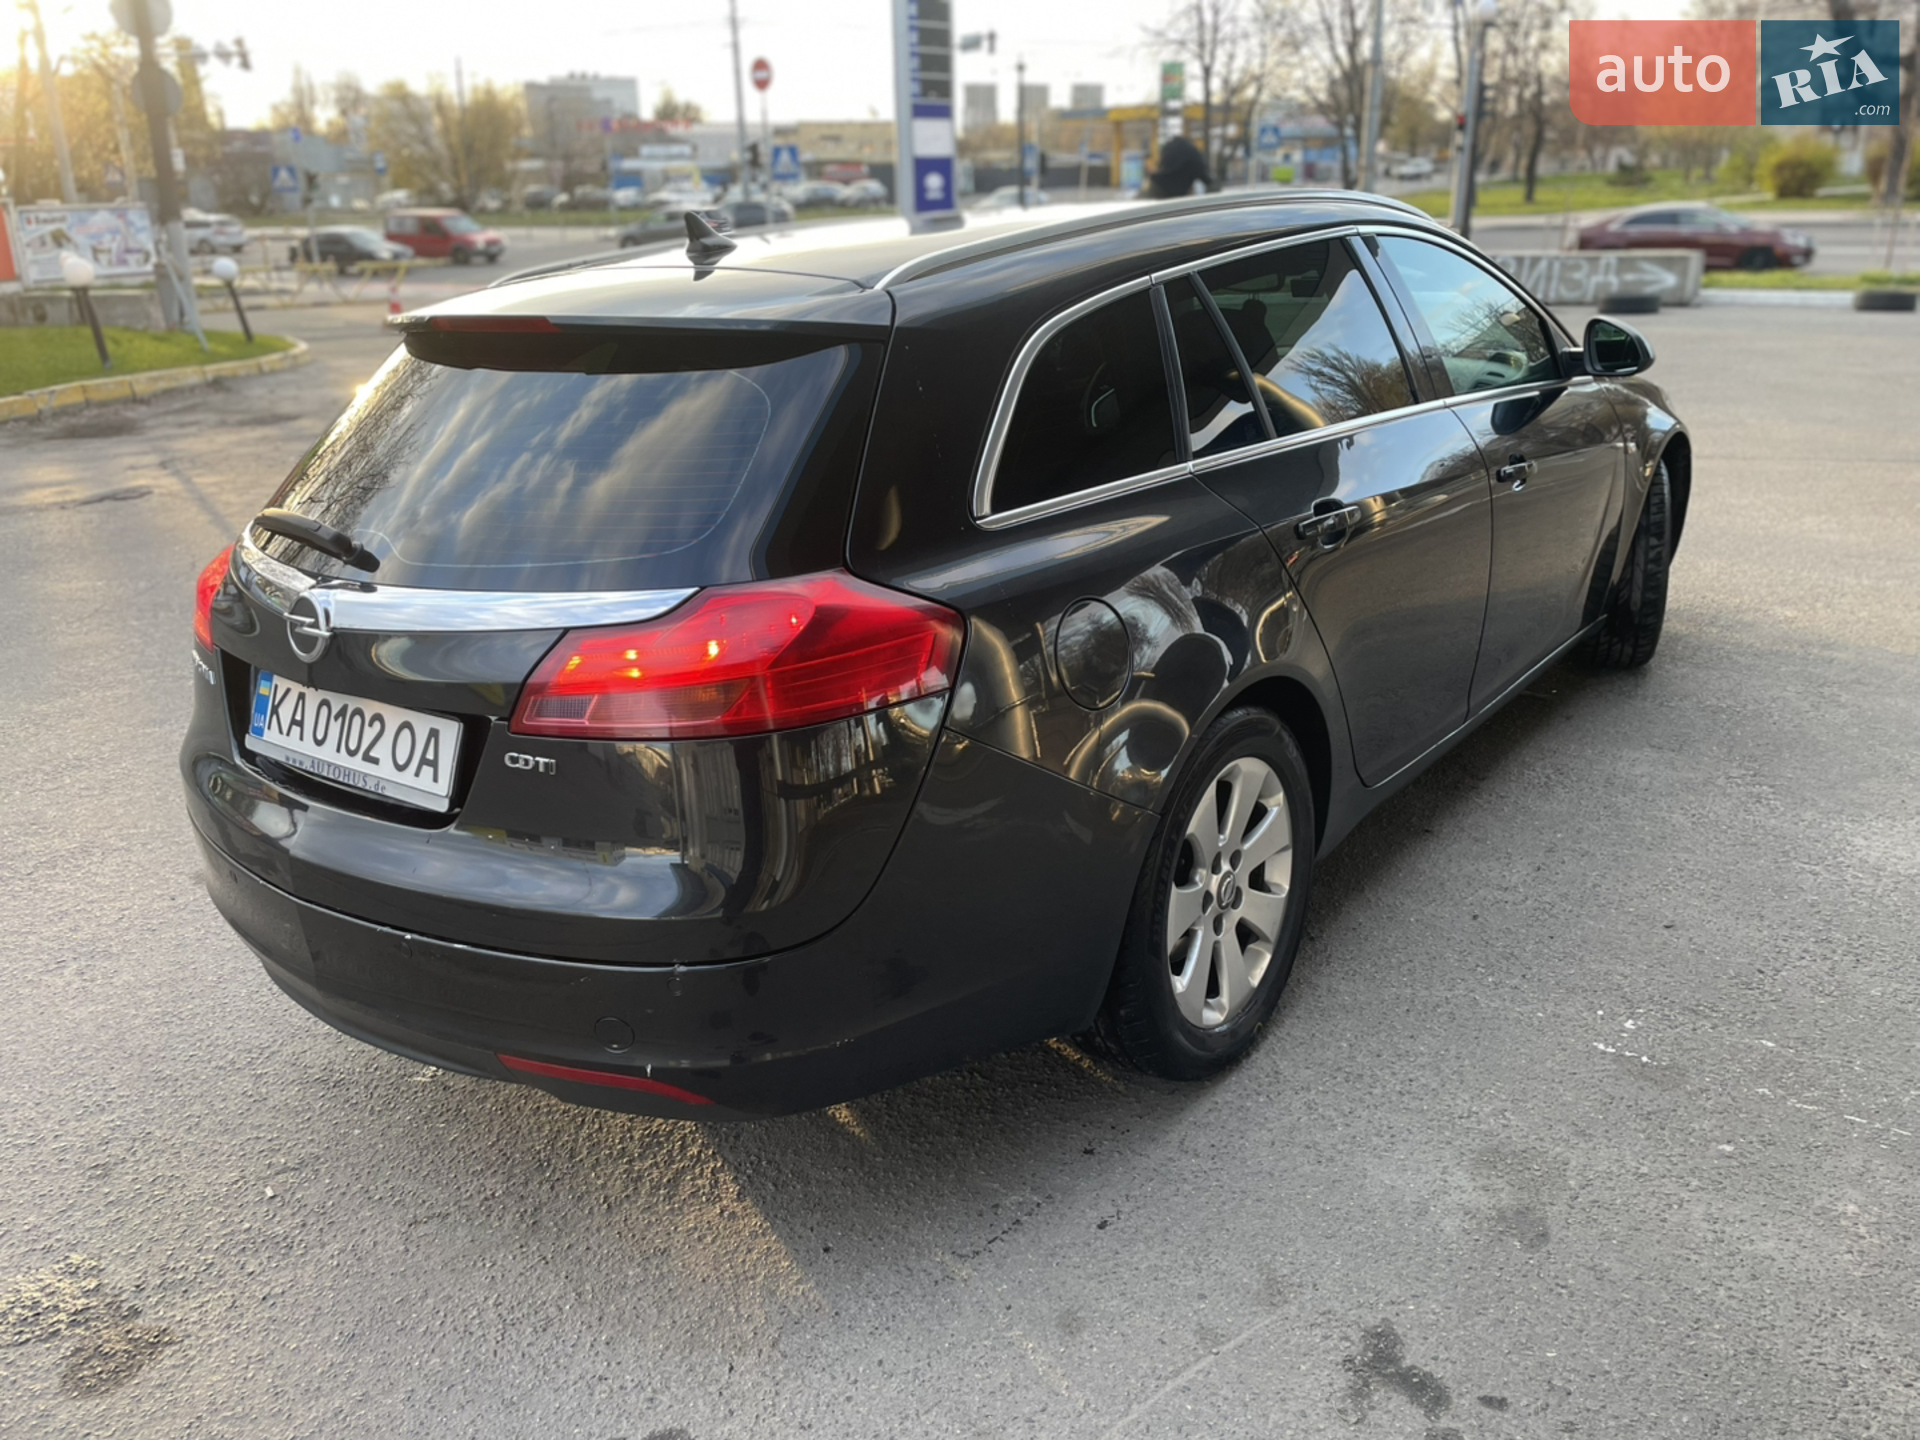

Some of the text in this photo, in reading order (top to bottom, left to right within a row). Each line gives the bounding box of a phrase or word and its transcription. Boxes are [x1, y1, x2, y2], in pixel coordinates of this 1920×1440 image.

[254, 712, 265, 729] UA
[267, 683, 441, 784] KA 0102 OA
[284, 754, 387, 794] www.AUTOHUS.de
